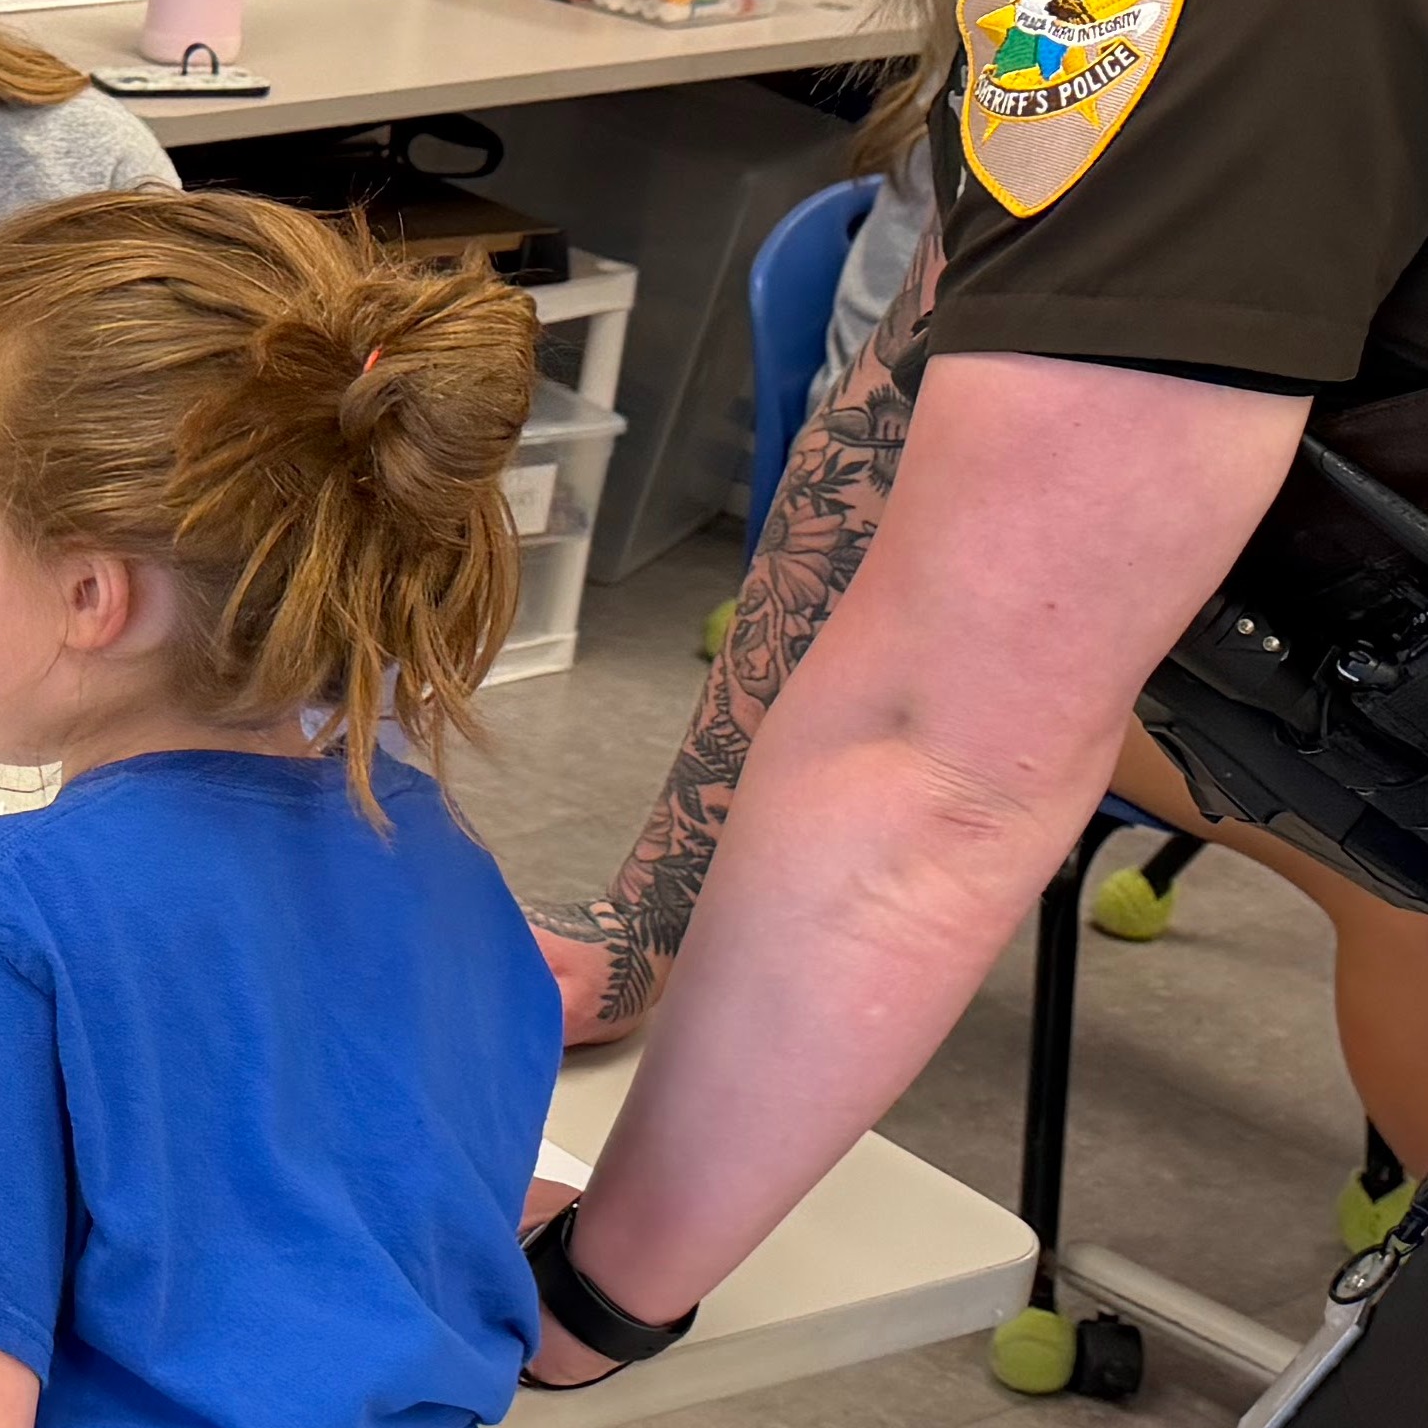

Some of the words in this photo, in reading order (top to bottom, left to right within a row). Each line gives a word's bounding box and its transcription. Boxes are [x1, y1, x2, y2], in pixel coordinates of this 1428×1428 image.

[1077, 9, 1143, 44] INTEGRITY
[974, 75, 1049, 115] SHERIFF'S
[1058, 43, 1137, 112] POLICE
